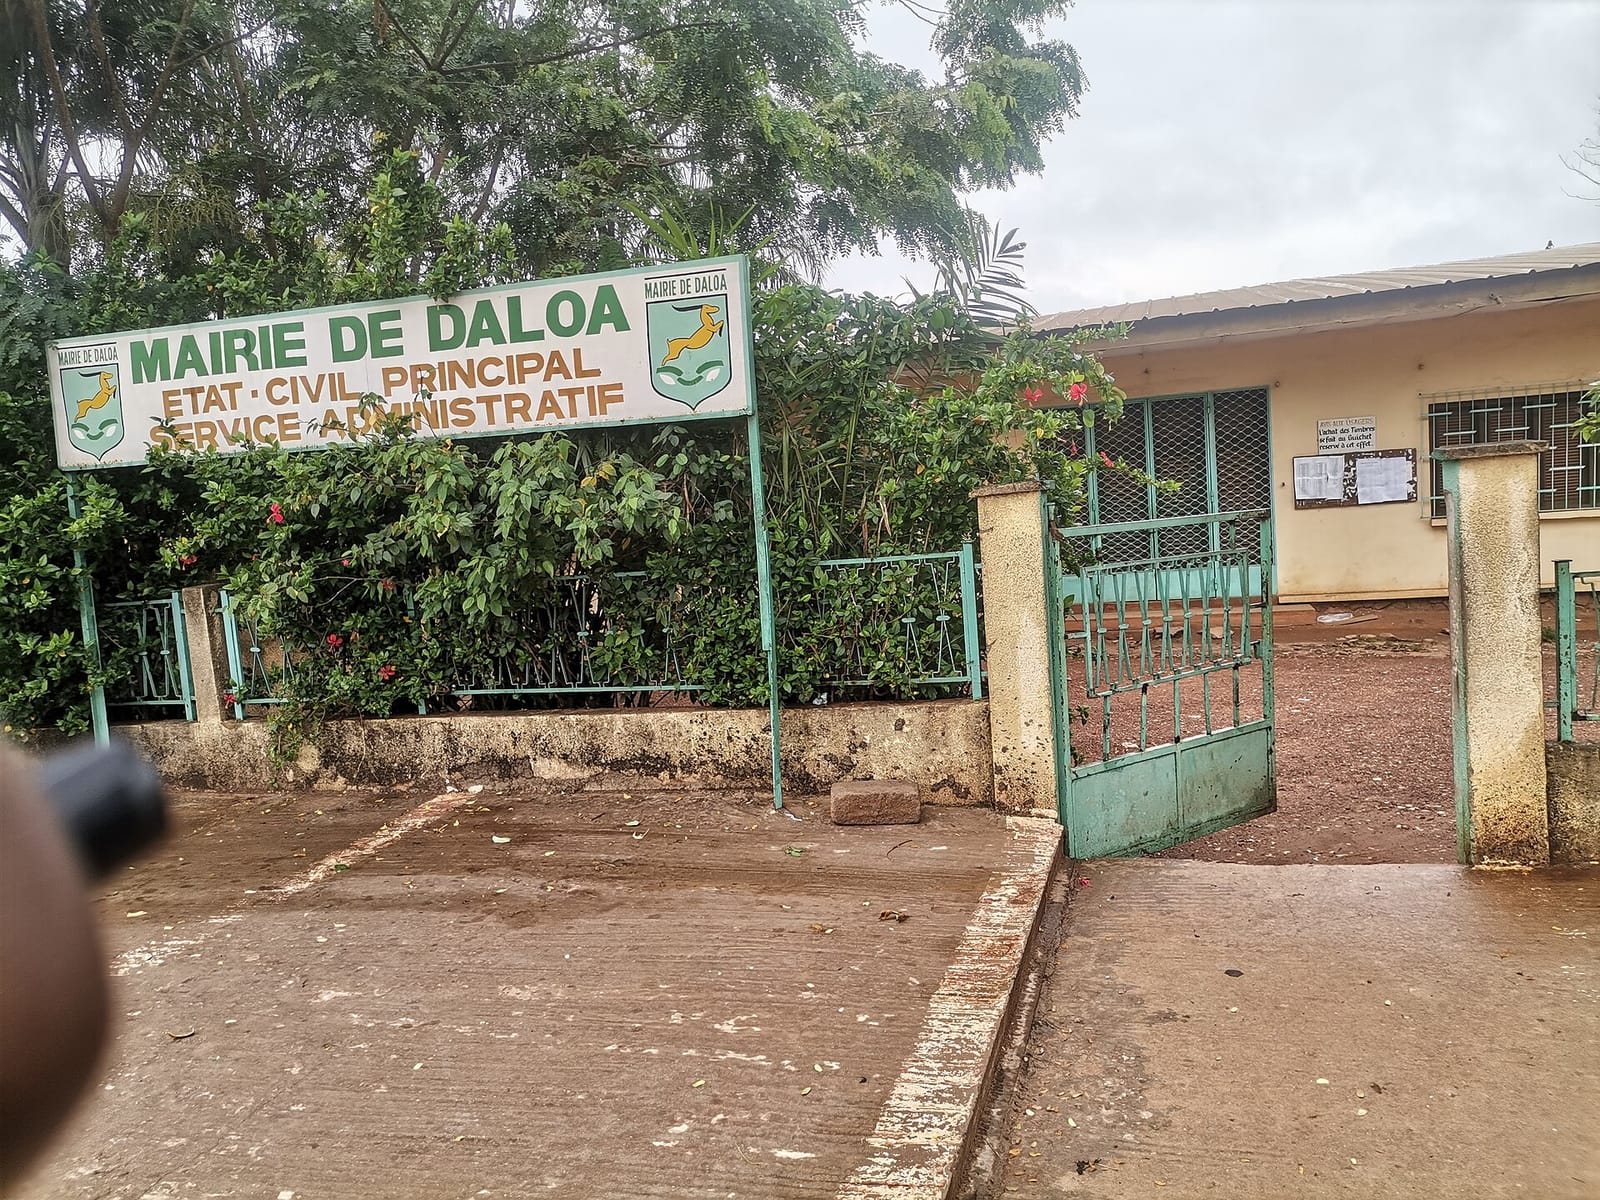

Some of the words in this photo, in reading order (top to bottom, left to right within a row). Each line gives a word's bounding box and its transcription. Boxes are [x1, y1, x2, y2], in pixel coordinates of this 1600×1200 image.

[644, 280, 677, 299] MAIRIE
[680, 278, 692, 295] DE
[695, 274, 728, 293] DALOA
[129, 321, 308, 385] MAIRIE
[328, 309, 405, 363] DE
[426, 284, 631, 353] DALOA
[57, 350, 81, 366] MAIRIE
[83, 349, 92, 363] DE
[94, 346, 119, 362] DALOA
[381, 348, 602, 397] PRINCIPAL
[149, 411, 302, 452] SERVICE
[1347, 433, 1372, 441] Guichet
